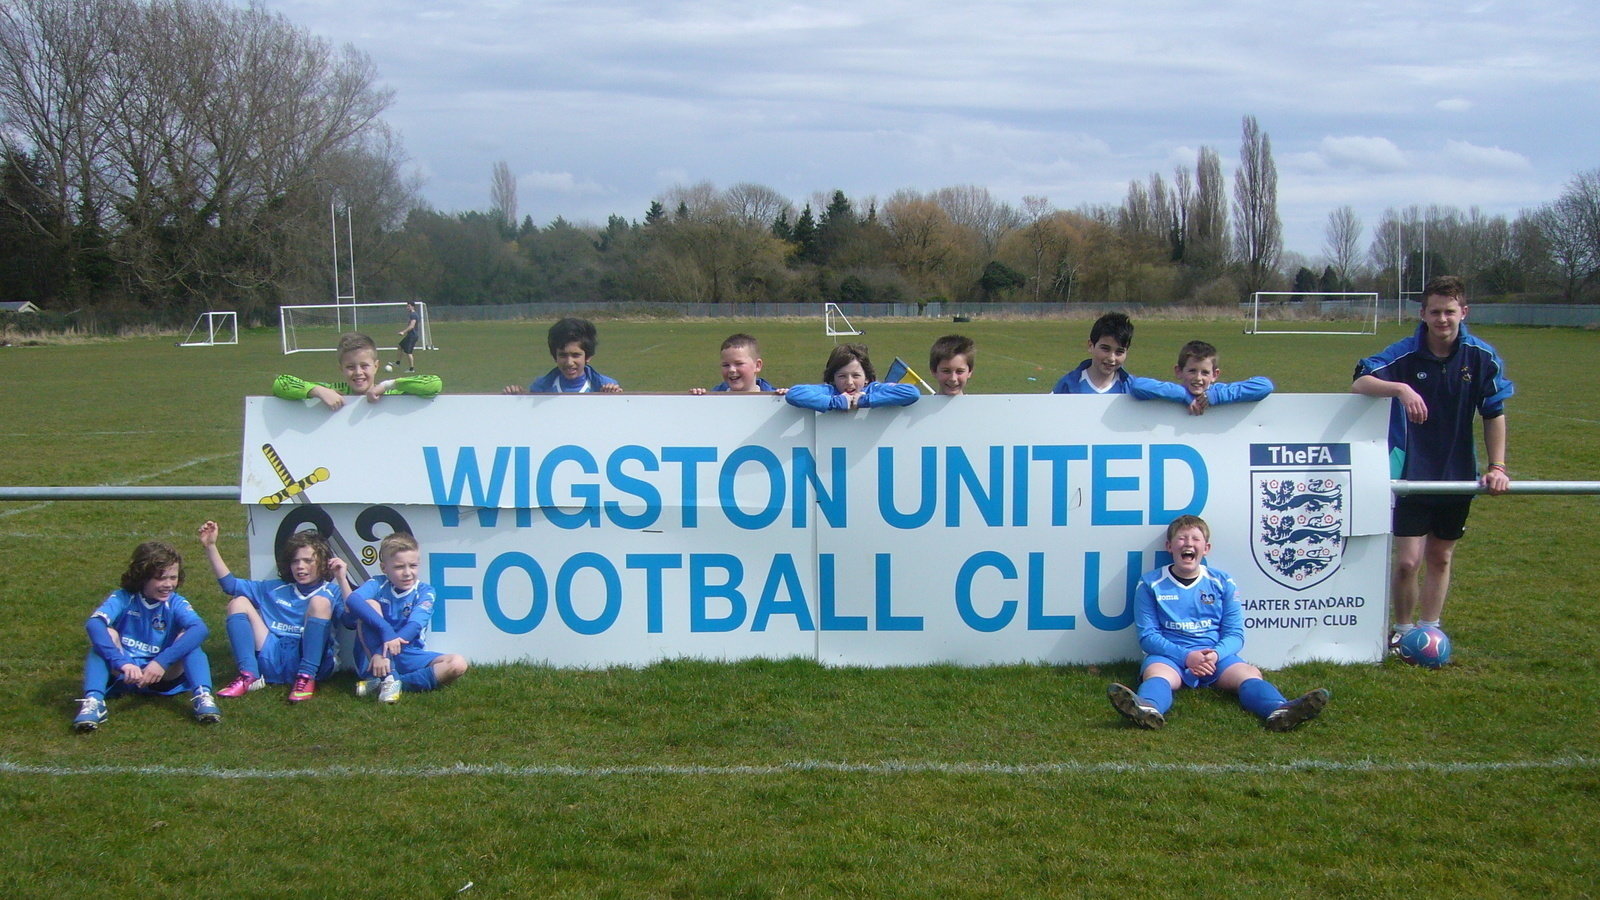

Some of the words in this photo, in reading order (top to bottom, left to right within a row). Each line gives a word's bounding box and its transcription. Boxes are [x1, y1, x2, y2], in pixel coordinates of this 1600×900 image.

[1268, 446, 1333, 464] TheFA
[422, 444, 847, 530] WIGSTON
[878, 443, 1209, 529] UNITED
[361, 545, 382, 566] 9
[429, 551, 924, 635] FOOTBALL
[955, 550, 1207, 633] CLU
[1241, 599, 1290, 610] HARTER
[1294, 597, 1365, 610] STANDARD
[1165, 620, 1212, 630] LEDHEADS
[1244, 617, 1317, 629] OMMUNIT
[1323, 615, 1358, 626] CLUB
[121, 637, 160, 654] EDHEAD
